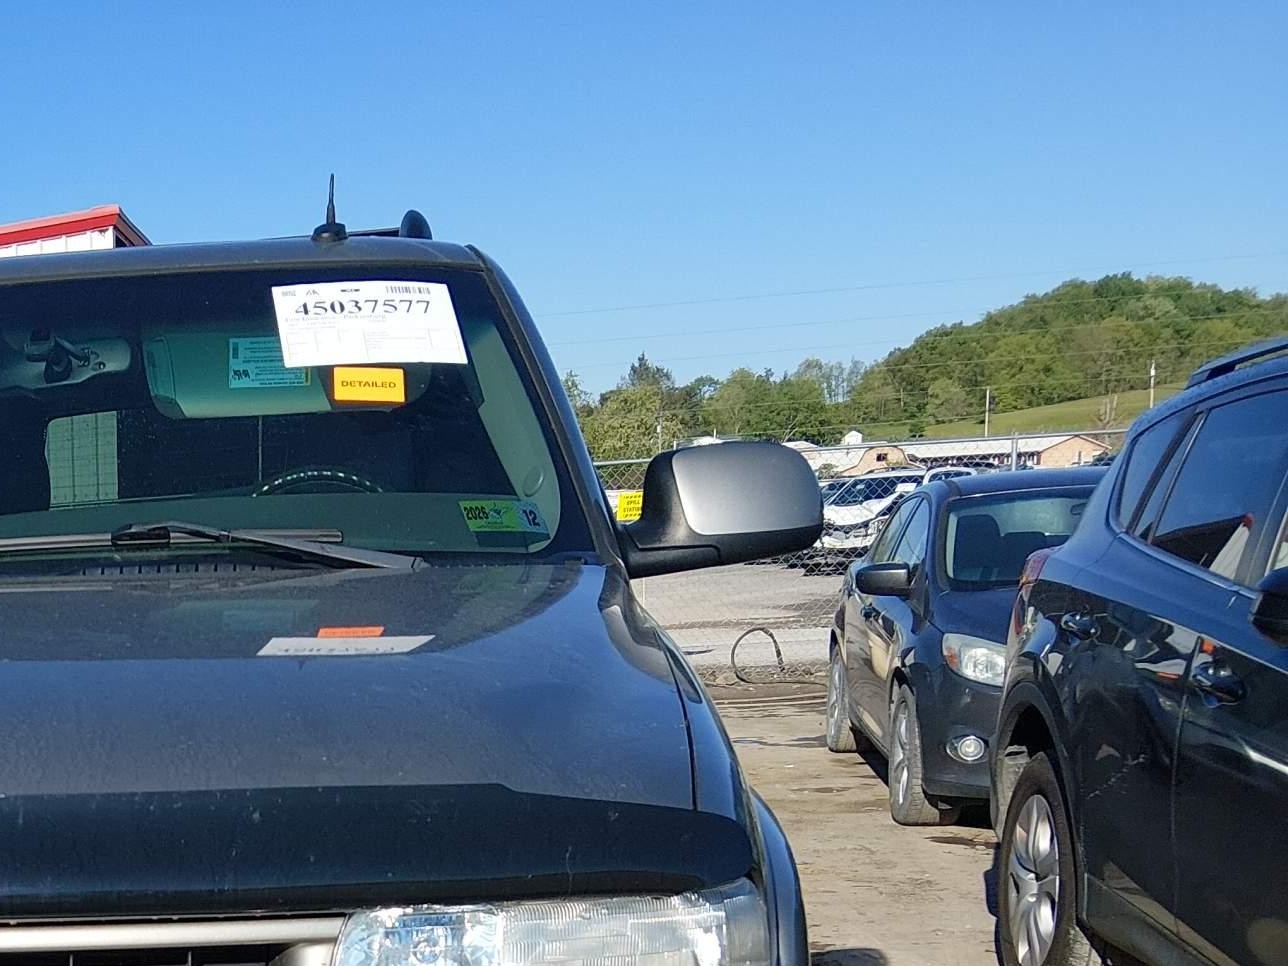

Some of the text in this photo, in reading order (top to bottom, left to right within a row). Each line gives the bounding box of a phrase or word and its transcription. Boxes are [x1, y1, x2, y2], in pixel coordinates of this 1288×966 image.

[295, 299, 431, 316] 45037577
[340, 380, 397, 389] DETAILED
[463, 505, 541, 527] 2026 12
